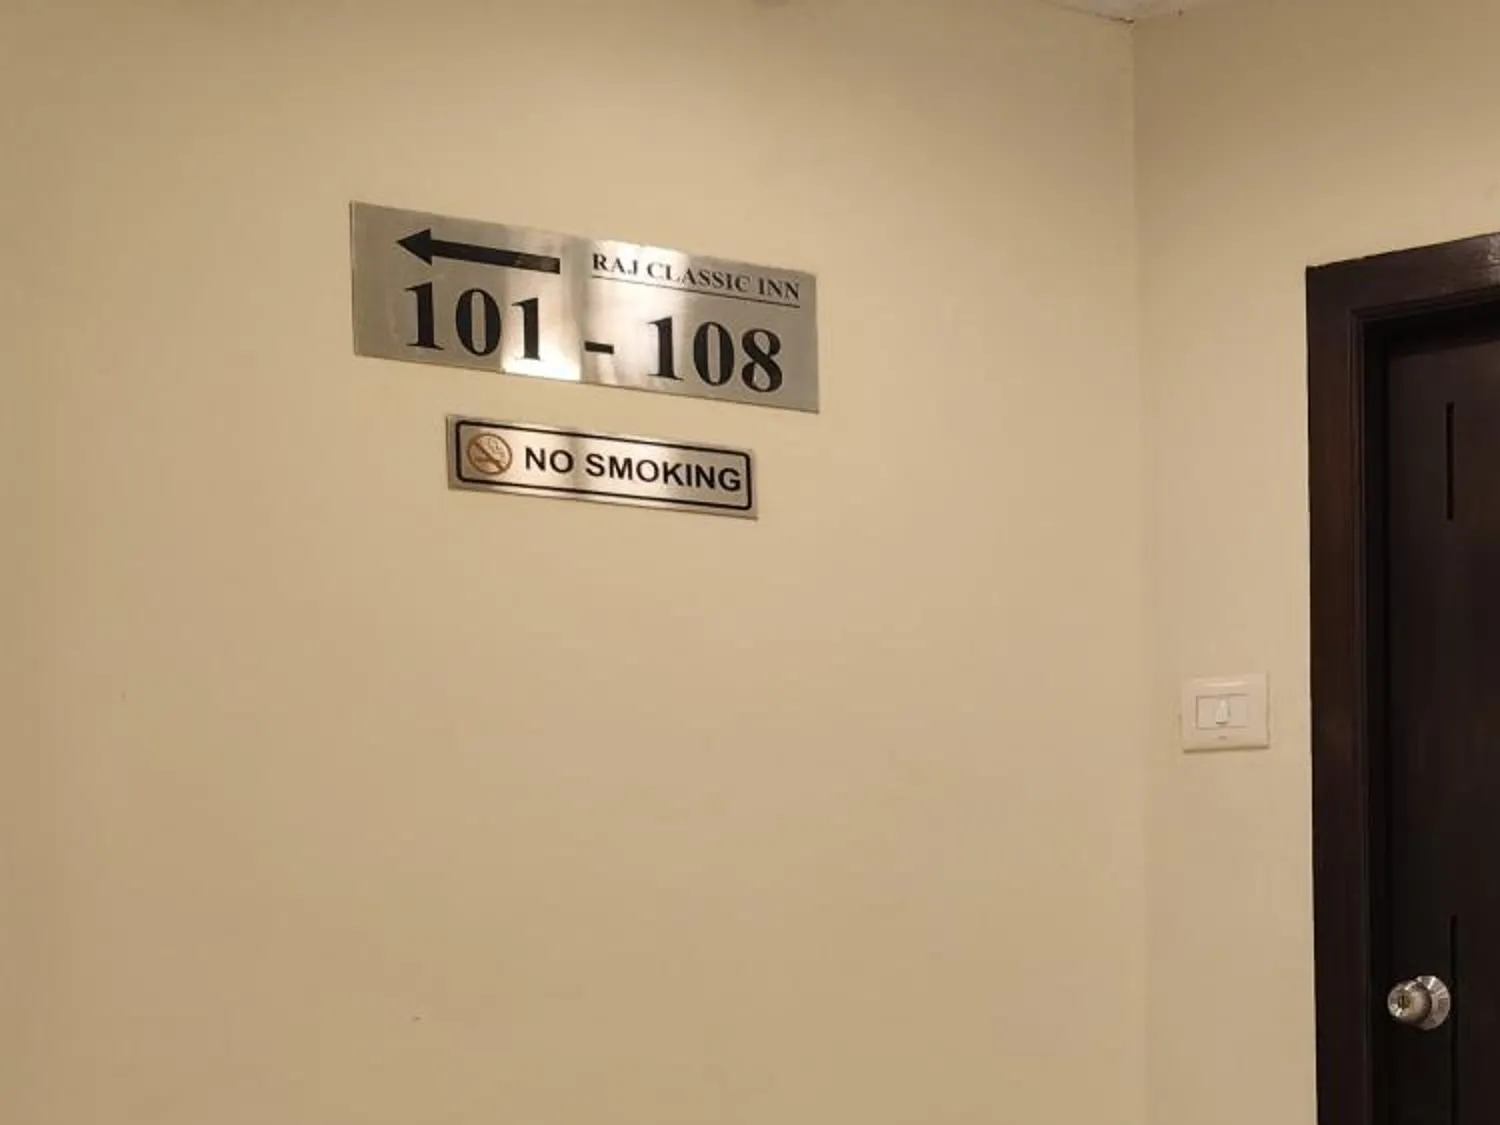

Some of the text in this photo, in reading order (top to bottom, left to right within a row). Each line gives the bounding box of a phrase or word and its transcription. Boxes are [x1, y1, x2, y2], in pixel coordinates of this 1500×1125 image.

[592, 252, 801, 300] RAJ CLASSIC INN
[406, 281, 783, 393] 101 - 108
[524, 446, 742, 492] NO SMOKING
